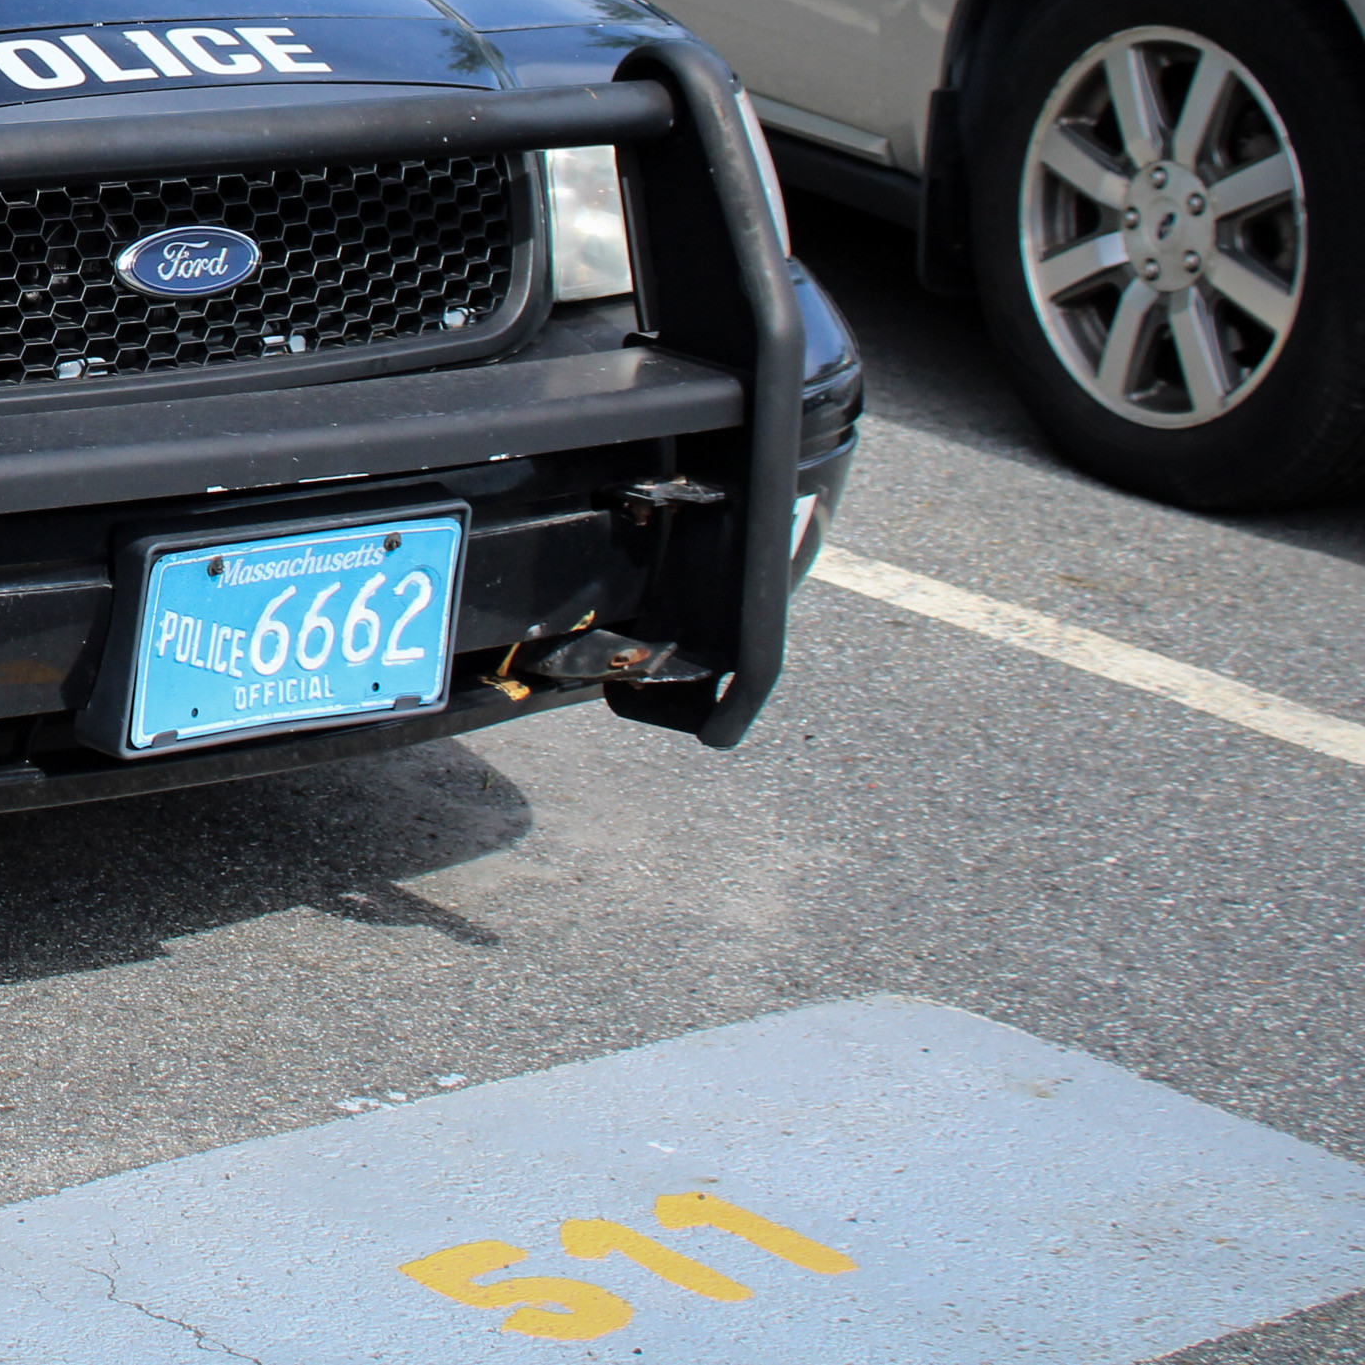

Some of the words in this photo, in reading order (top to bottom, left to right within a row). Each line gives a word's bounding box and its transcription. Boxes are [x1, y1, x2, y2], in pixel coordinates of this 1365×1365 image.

[158, 241, 228, 281] Ford
[219, 545, 385, 589] Massachusetts
[156, 609, 247, 678] POLICE
[249, 570, 433, 676] 6662
[234, 674, 335, 711] OFFICIAL
[398, 1192, 858, 1340] 511
